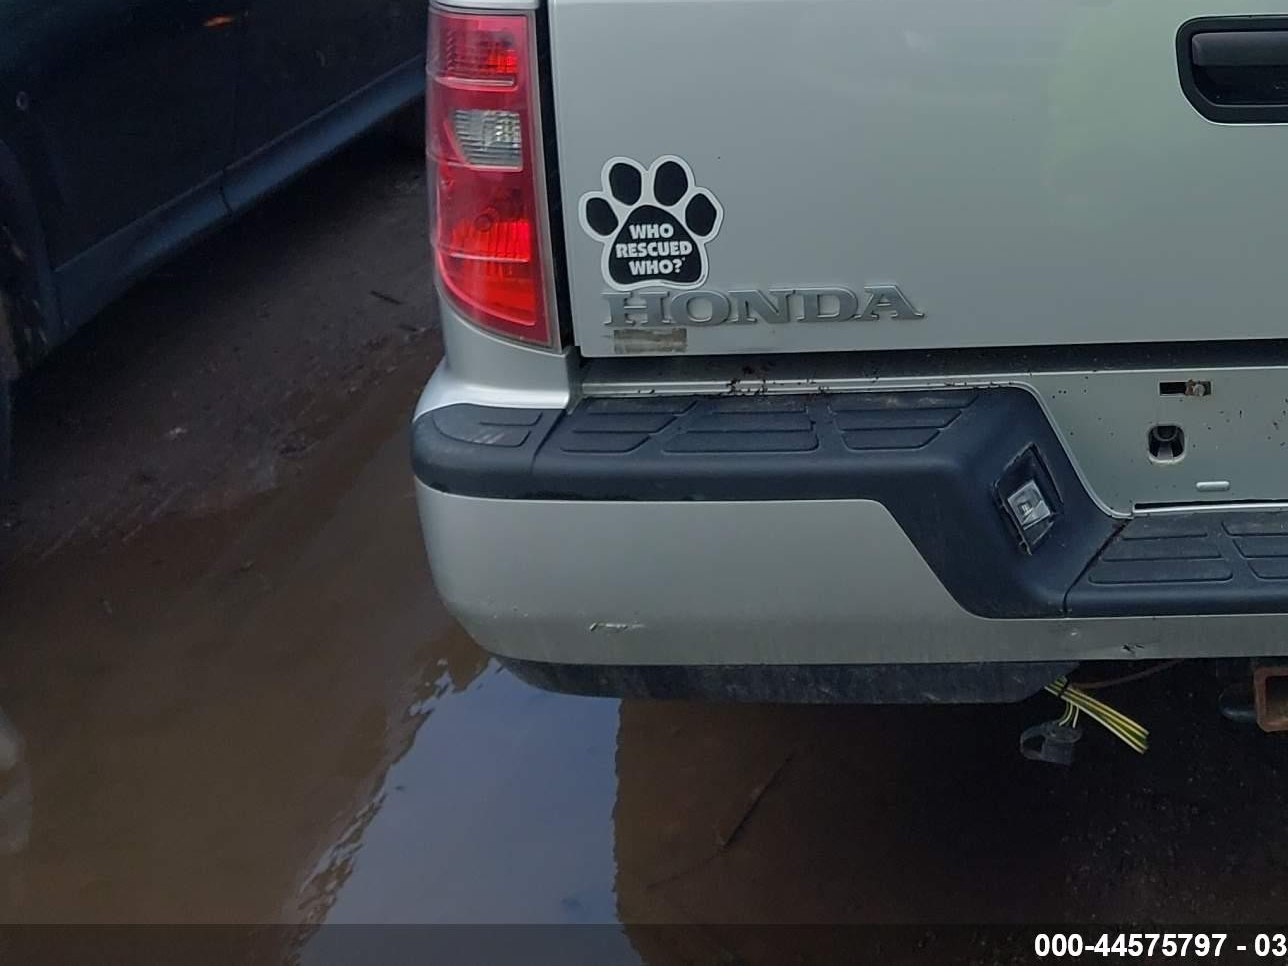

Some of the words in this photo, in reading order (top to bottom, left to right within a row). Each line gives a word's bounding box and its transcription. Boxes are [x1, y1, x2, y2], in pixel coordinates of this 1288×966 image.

[629, 223, 674, 239] WHO
[616, 241, 693, 258] RESCUED
[628, 258, 682, 275] WHO?
[601, 284, 925, 327] HONDA
